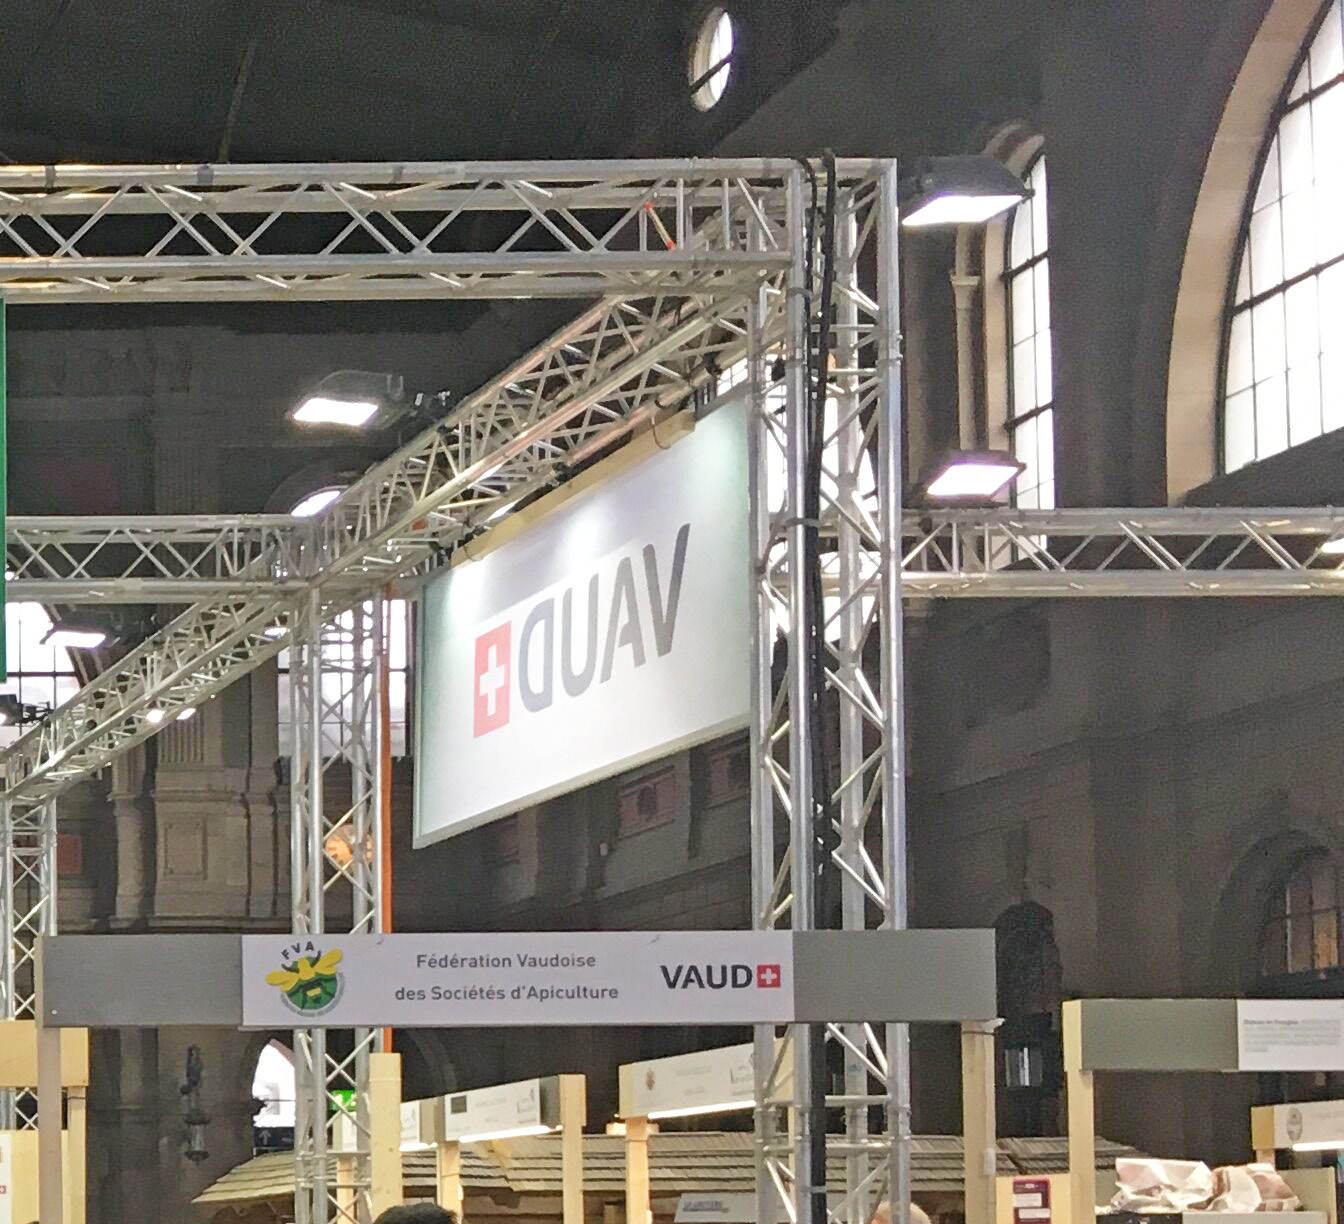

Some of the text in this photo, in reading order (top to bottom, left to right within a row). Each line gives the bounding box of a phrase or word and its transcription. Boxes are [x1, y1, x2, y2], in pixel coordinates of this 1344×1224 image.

[416, 953, 596, 968] Fédération Vaudoise
[660, 964, 754, 990] VAUD
[394, 984, 619, 1002] des Sociétés d'Apiculture
